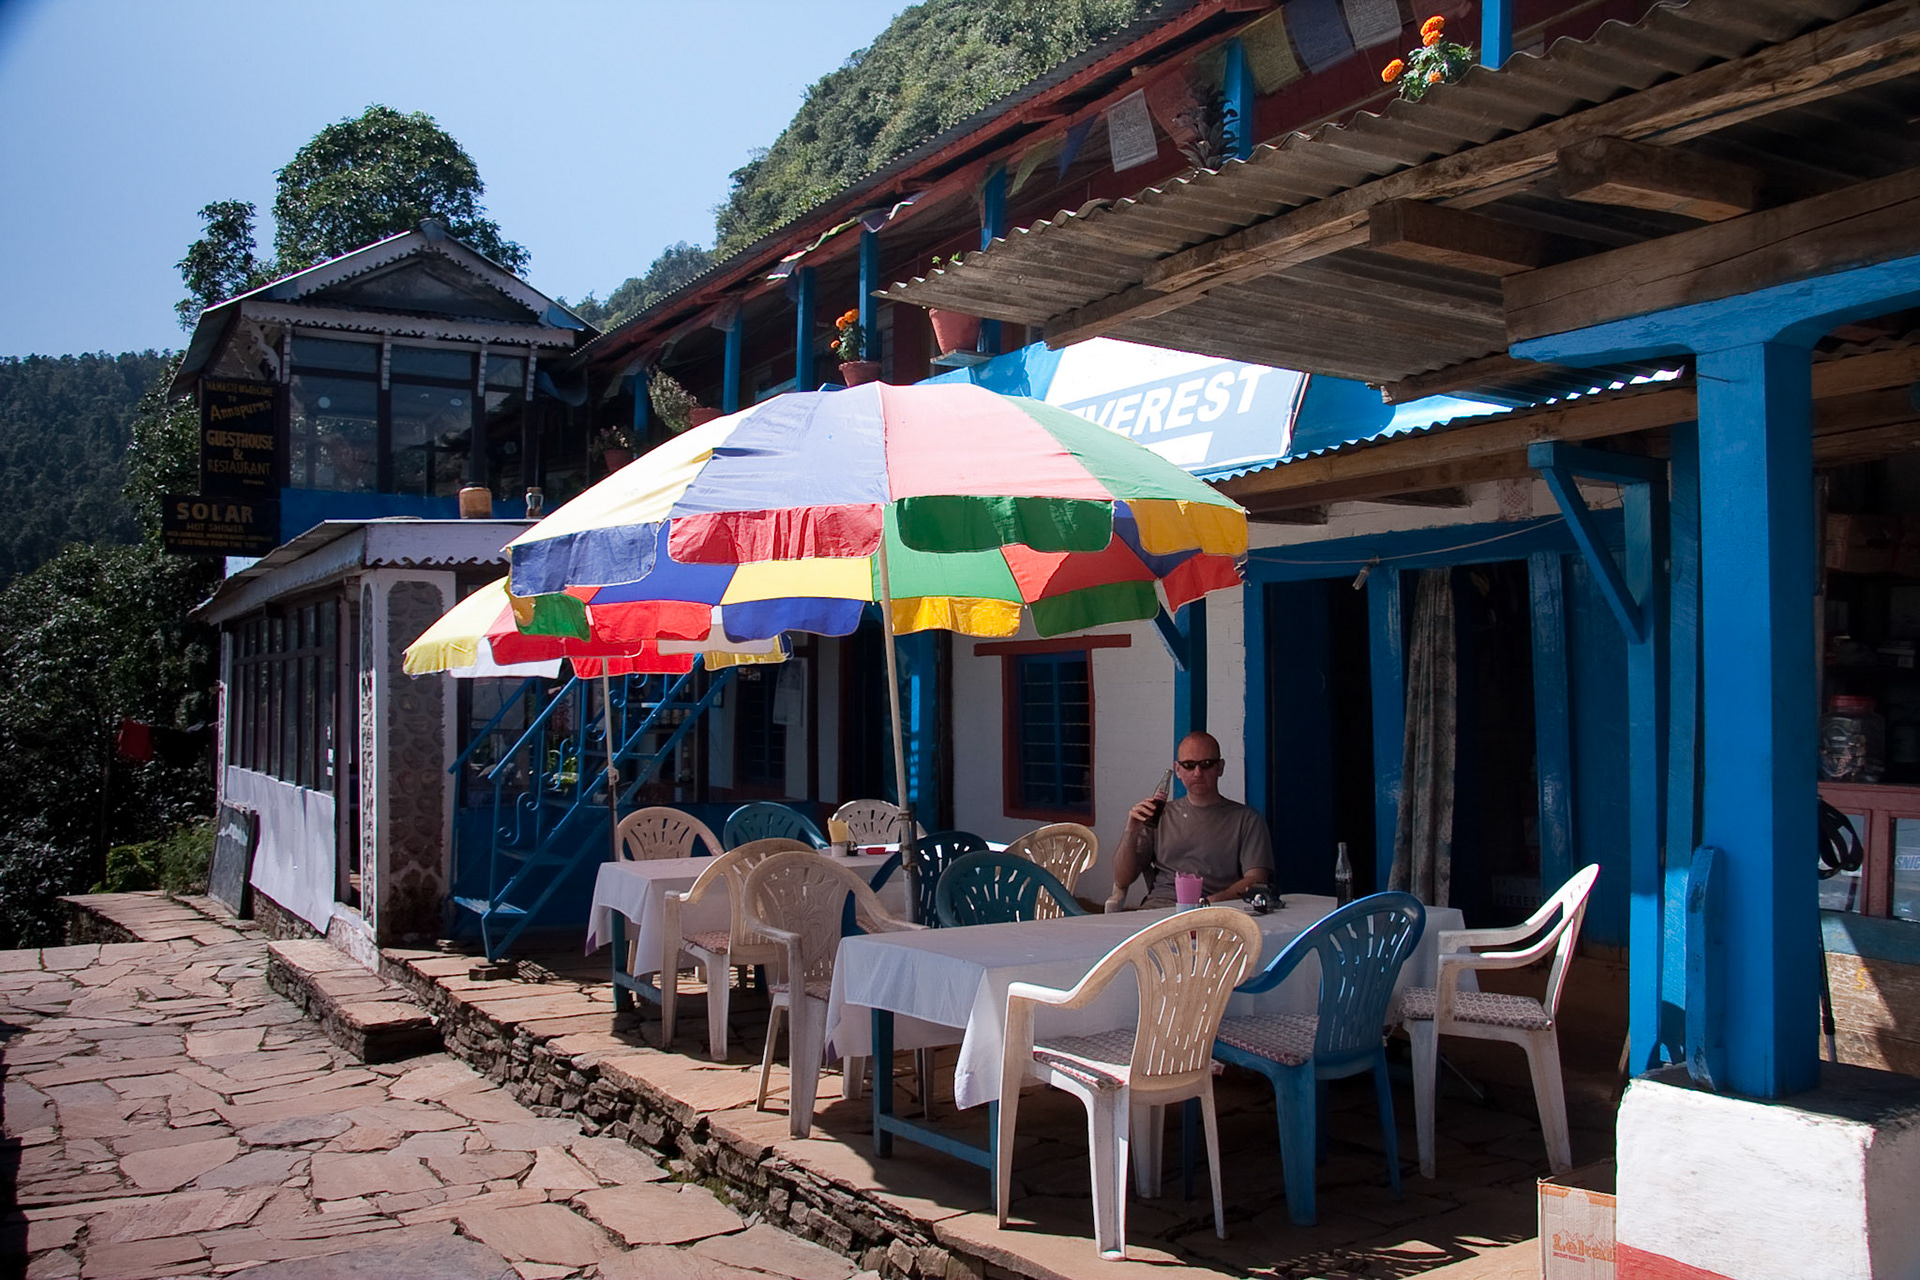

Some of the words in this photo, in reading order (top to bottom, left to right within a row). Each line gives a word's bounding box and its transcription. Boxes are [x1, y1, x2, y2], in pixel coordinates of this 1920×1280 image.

[210, 401, 271, 421] Annapurna
[207, 430, 274, 450] GUESTHOUSE
[233, 449, 243, 460] &
[208, 459, 270, 475] RESTAURANT
[177, 502, 254, 523] SOLAR
[186, 522, 205, 531] HOT
[208, 523, 245, 533] SHOWER
